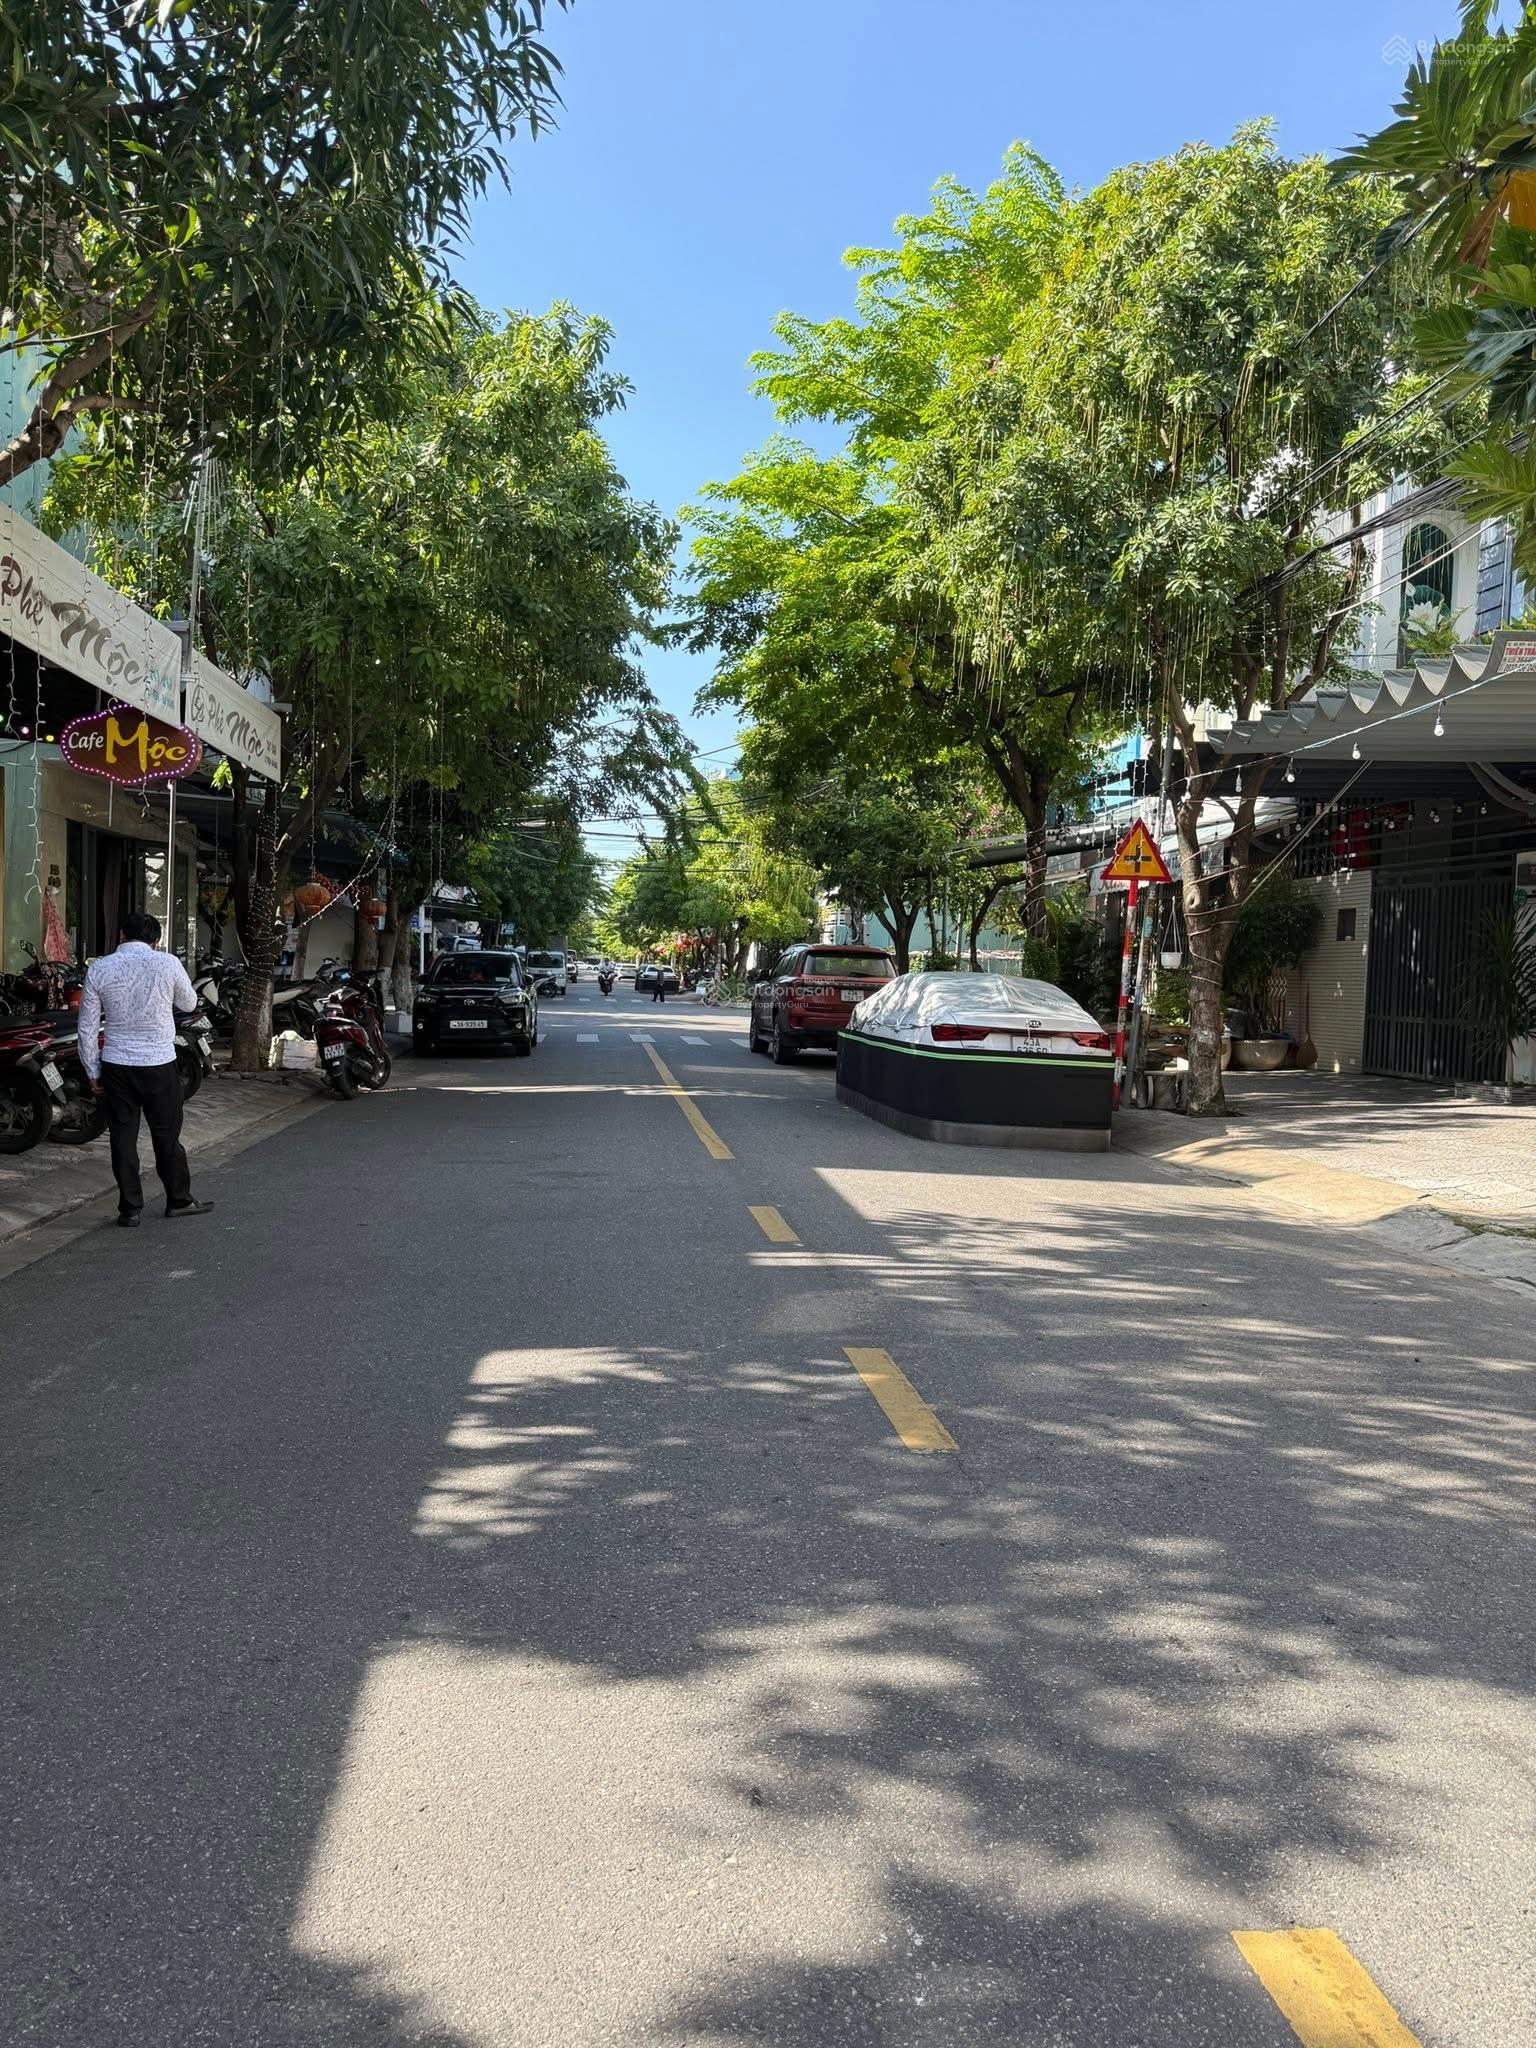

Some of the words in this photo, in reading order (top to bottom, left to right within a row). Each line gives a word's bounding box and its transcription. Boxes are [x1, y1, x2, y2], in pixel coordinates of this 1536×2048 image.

[51, 601, 143, 687] Mộc
[68, 731, 104, 750] Cafe
[105, 717, 188, 773] Mộc
[226, 711, 265, 762] Mộc
[1024, 1037, 1040, 1046] 43A
